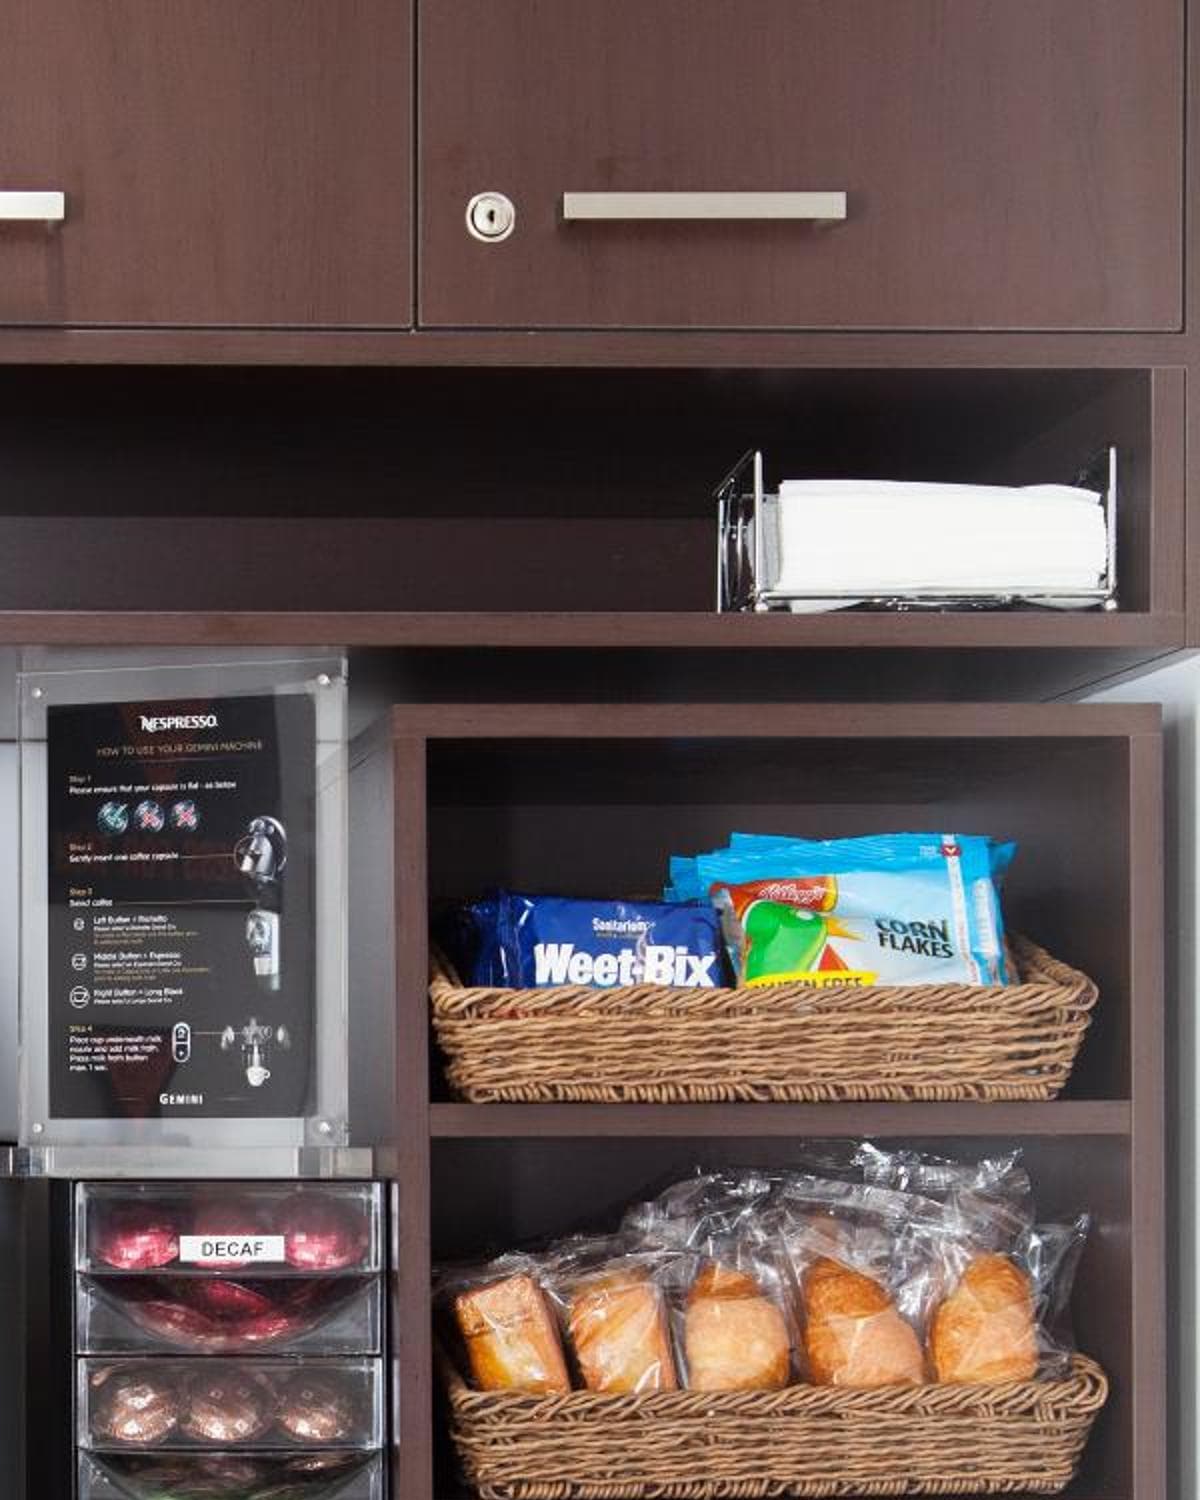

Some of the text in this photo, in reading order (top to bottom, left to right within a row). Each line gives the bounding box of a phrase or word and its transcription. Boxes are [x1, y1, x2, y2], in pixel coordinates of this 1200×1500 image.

[875, 918, 948, 942] CORN
[878, 931, 954, 959] FLAKES
[159, 1093, 203, 1105] GEMINI
[201, 1241, 264, 1257] DECAF
